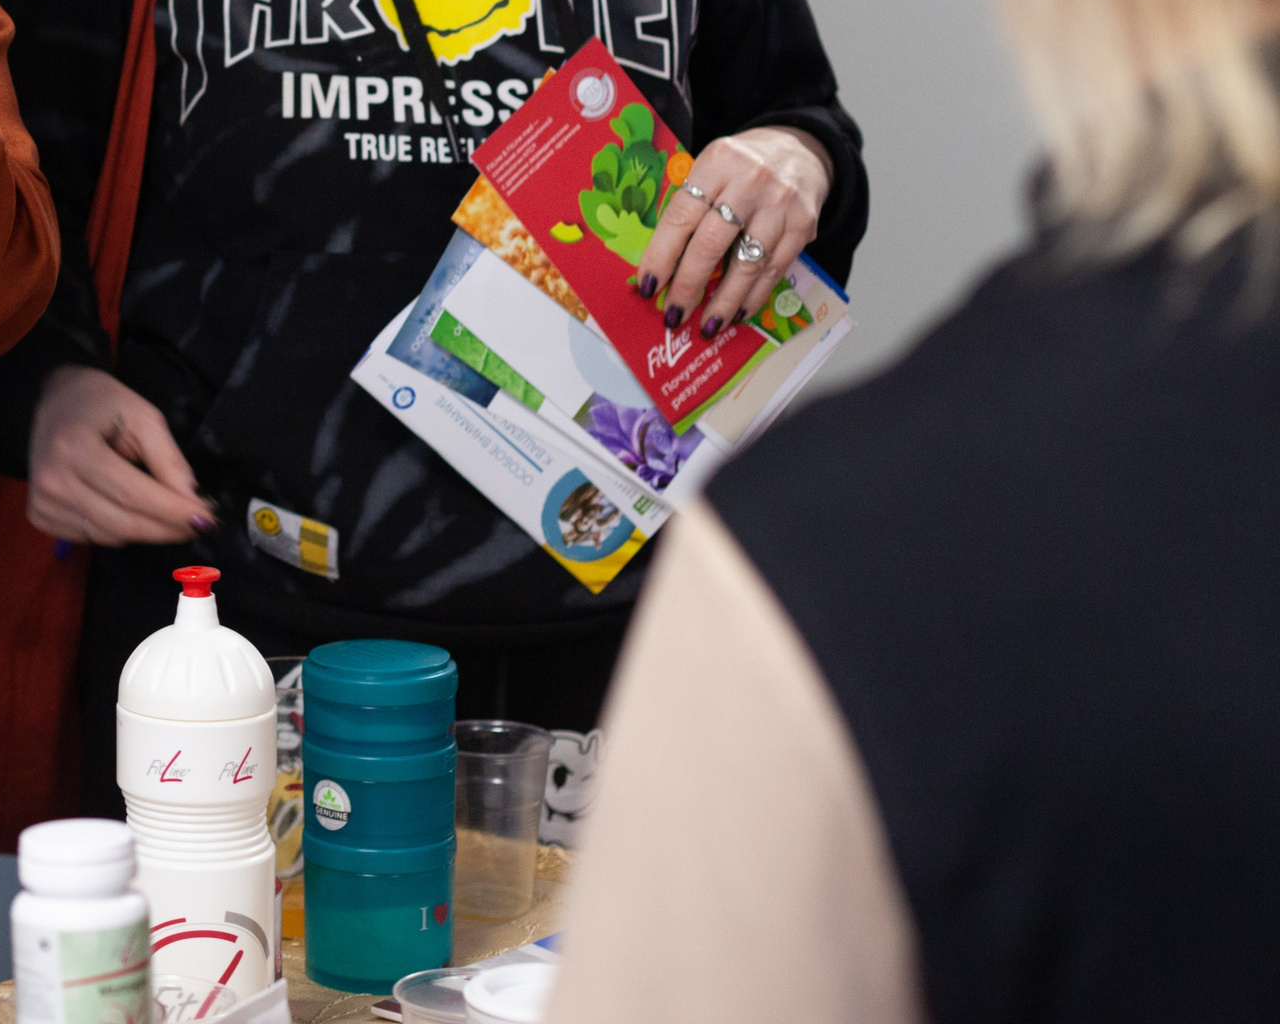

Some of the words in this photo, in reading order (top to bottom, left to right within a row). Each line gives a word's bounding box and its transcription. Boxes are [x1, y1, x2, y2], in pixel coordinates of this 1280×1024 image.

[344, 132, 413, 162] TRUE
[671, 357, 723, 411] результат
[146, 750, 188, 783] FitLine
[218, 747, 258, 784] FitLine
[315, 805, 349, 822] GENUINE
